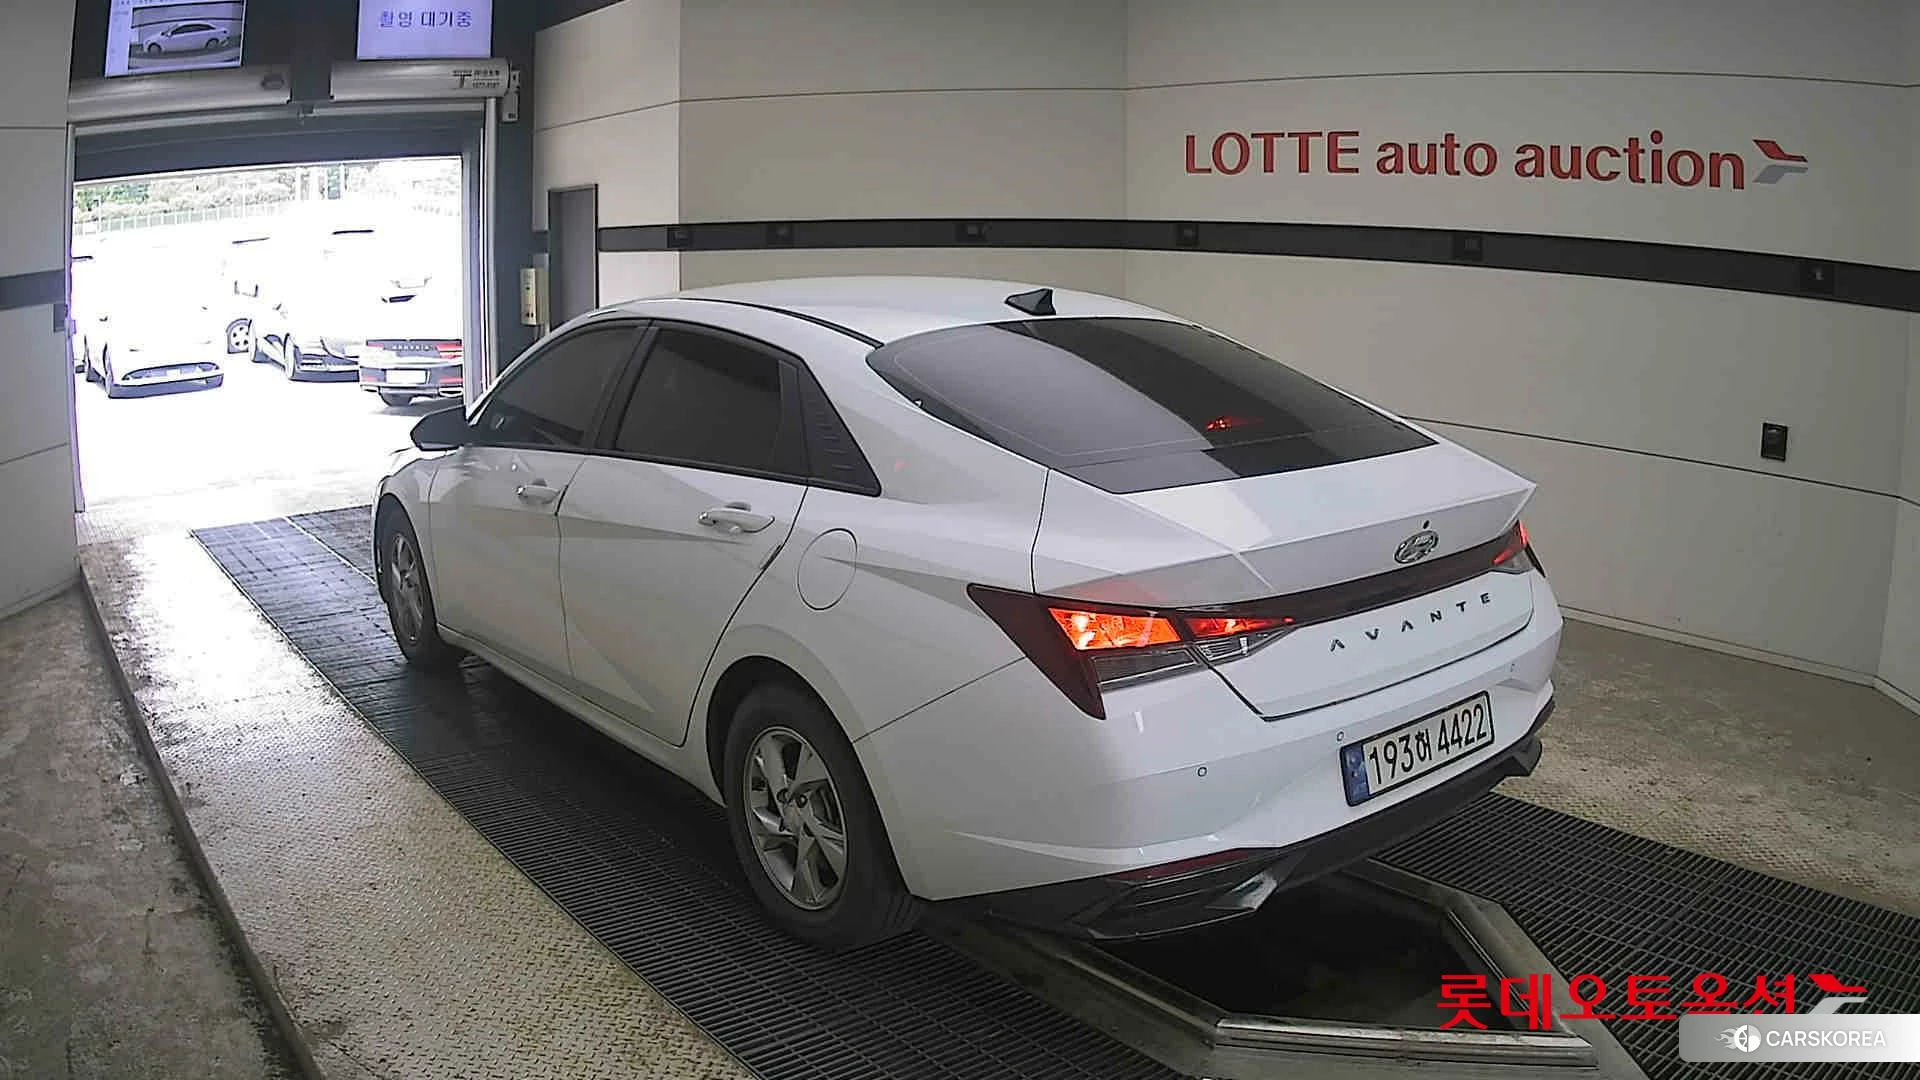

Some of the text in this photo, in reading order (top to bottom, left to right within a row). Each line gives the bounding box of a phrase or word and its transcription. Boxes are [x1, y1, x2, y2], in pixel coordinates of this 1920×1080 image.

[420, 10, 471, 28] 대기중
[1185, 130, 1745, 189] LOTTE auto auction
[1330, 592, 1491, 652] AVANTE
